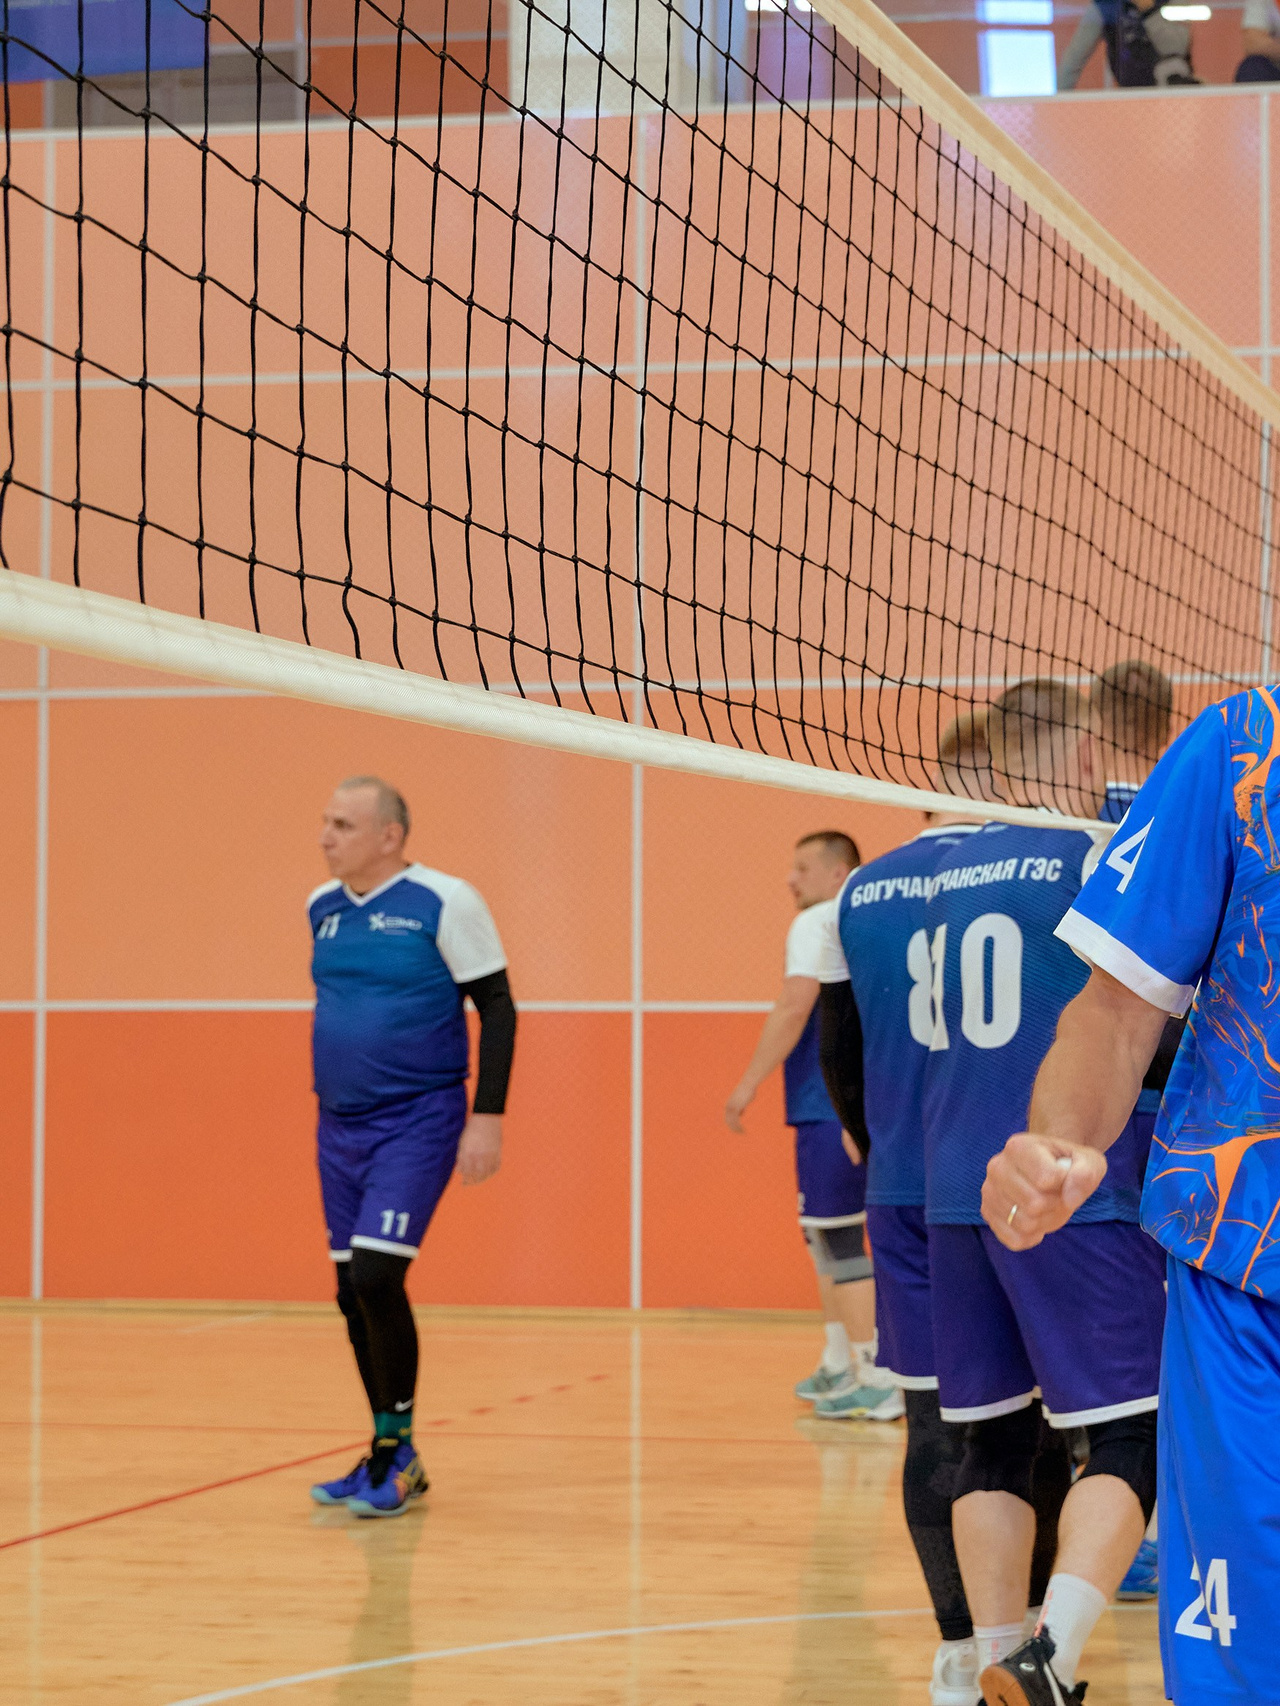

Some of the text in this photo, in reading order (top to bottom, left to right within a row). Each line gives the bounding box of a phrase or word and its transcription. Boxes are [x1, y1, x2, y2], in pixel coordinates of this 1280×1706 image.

[1018, 857, 1063, 882] ГЭС
[1093, 808, 1155, 894] 4
[380, 1209, 411, 1238] 11
[1174, 1555, 1237, 1646] 24
